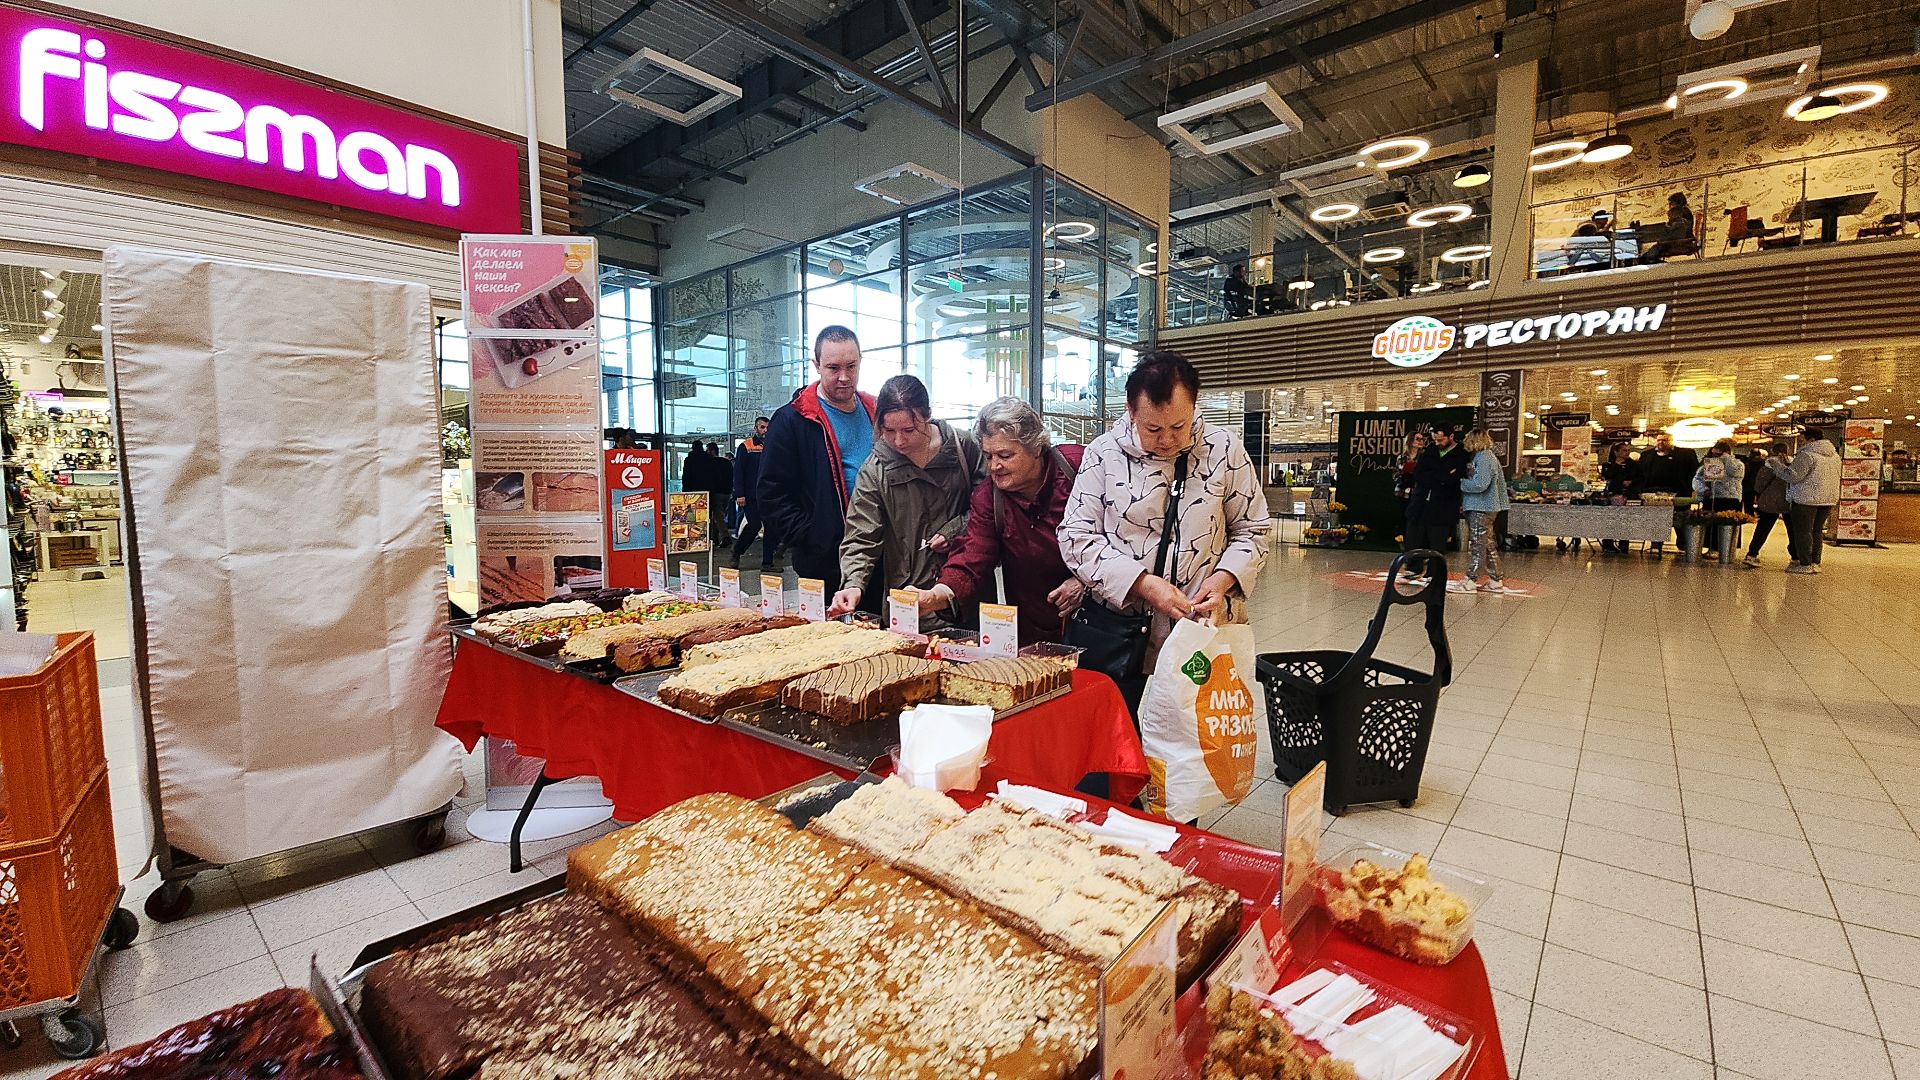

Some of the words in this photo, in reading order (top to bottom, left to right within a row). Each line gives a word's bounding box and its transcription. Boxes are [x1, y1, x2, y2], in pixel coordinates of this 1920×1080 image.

[19, 27, 461, 207] fiszman
[473, 247, 498, 258] Как
[500, 248, 523, 258] мы
[472, 260, 524, 270] делаем
[474, 271, 507, 281] наши
[475, 282, 522, 293] кексы?
[1463, 303, 1667, 349] РЕСТОРАН
[1355, 418, 1406, 438] LUMEN
